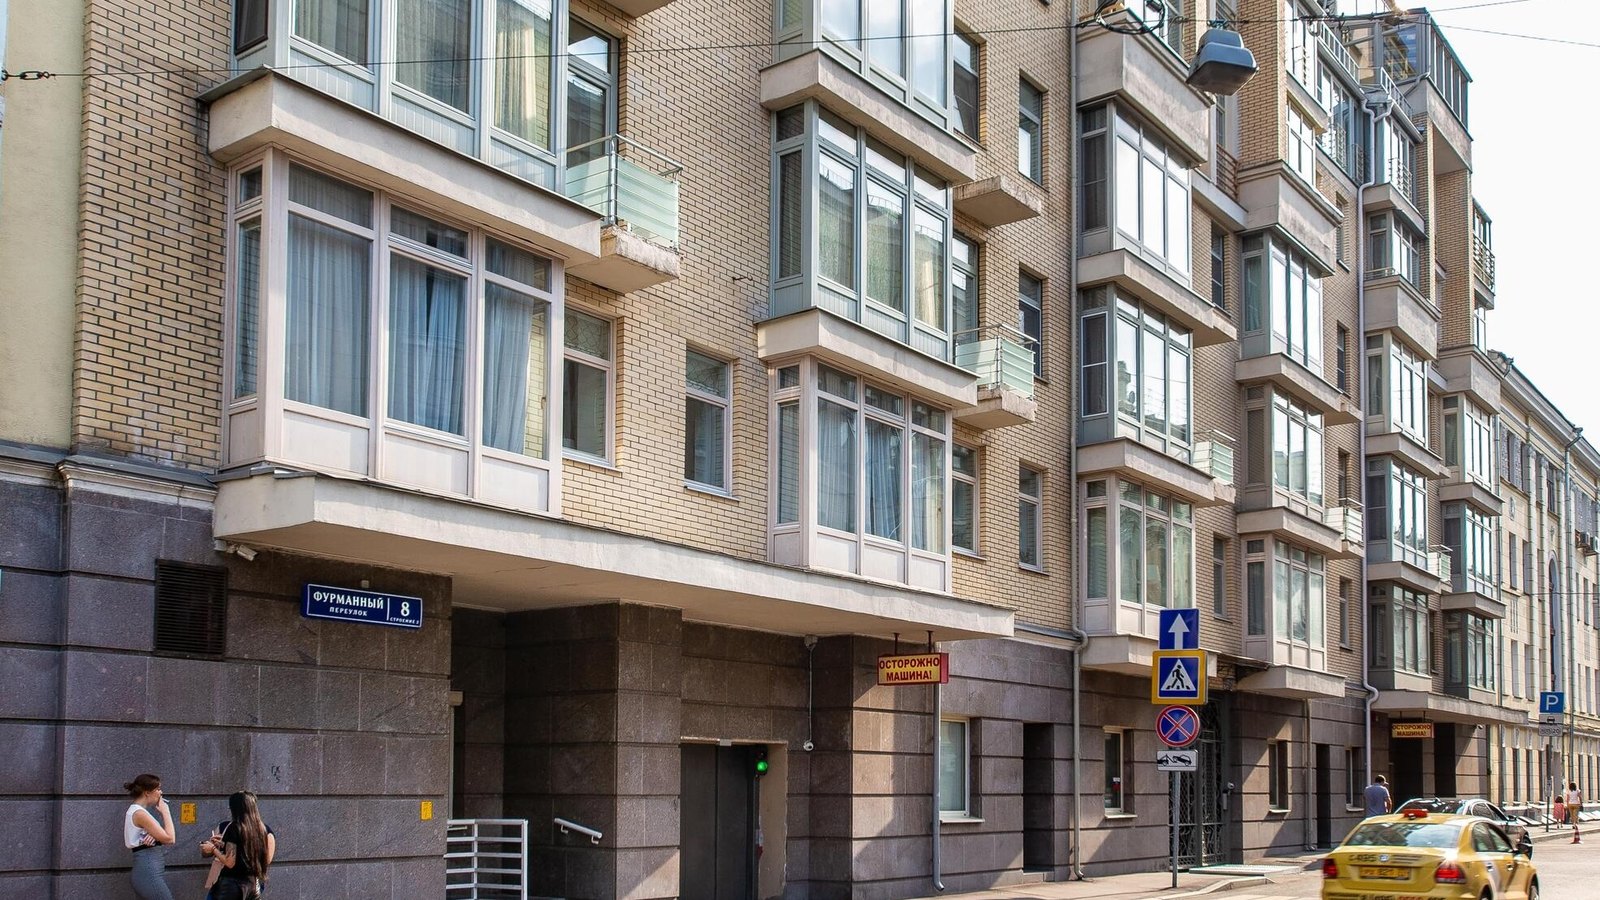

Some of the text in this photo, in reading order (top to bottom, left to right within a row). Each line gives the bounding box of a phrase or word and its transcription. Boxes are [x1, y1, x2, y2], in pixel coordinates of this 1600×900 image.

[313, 591, 384, 609] ФУРМАННЫЙ
[329, 606, 368, 617] ПЕРЕУЛОК
[400, 601, 410, 617] 8
[879, 657, 940, 670] ОСТОРОЖНО
[886, 670, 933, 682] МАШИНА!
[1546, 694, 1559, 711] P
